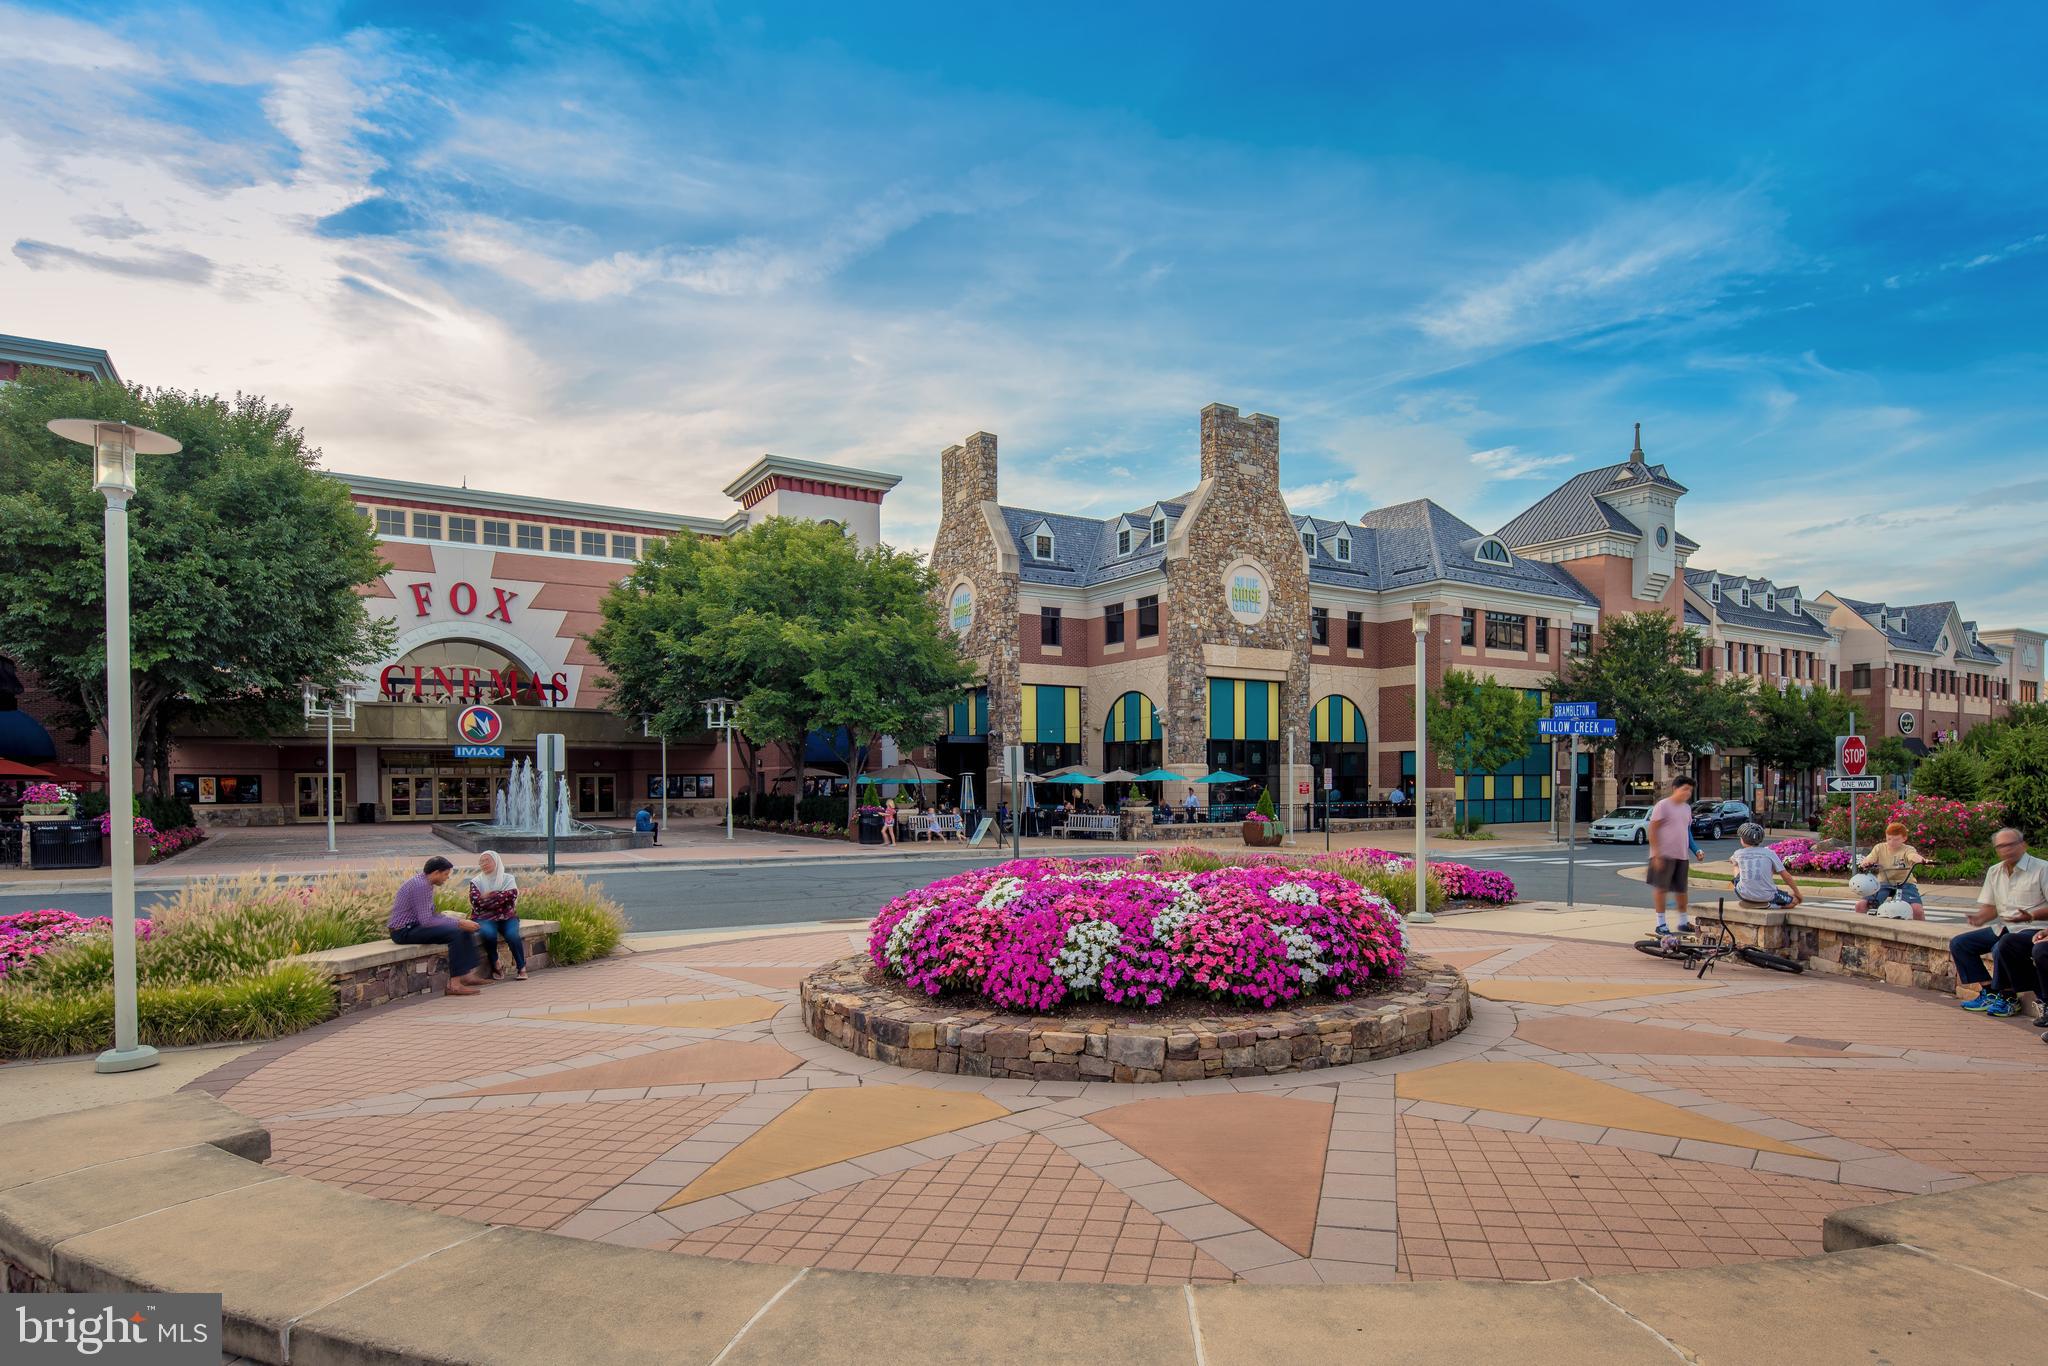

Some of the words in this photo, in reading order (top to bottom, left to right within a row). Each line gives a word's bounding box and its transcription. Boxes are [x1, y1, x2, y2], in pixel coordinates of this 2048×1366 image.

[1232, 587, 1261, 603] RIDGE
[408, 582, 518, 623] FOX
[1233, 600, 1261, 614] GRILL
[380, 664, 569, 702] CINEMAS
[1554, 704, 1590, 718] BRAMBLETON
[1540, 721, 1570, 733] WILLOW
[1574, 721, 1600, 733] CREEK
[456, 747, 501, 756] IMAX
[1844, 748, 1865, 764] STOP
[1841, 780, 1856, 788] ONE
[1857, 780, 1873, 788] WAY
